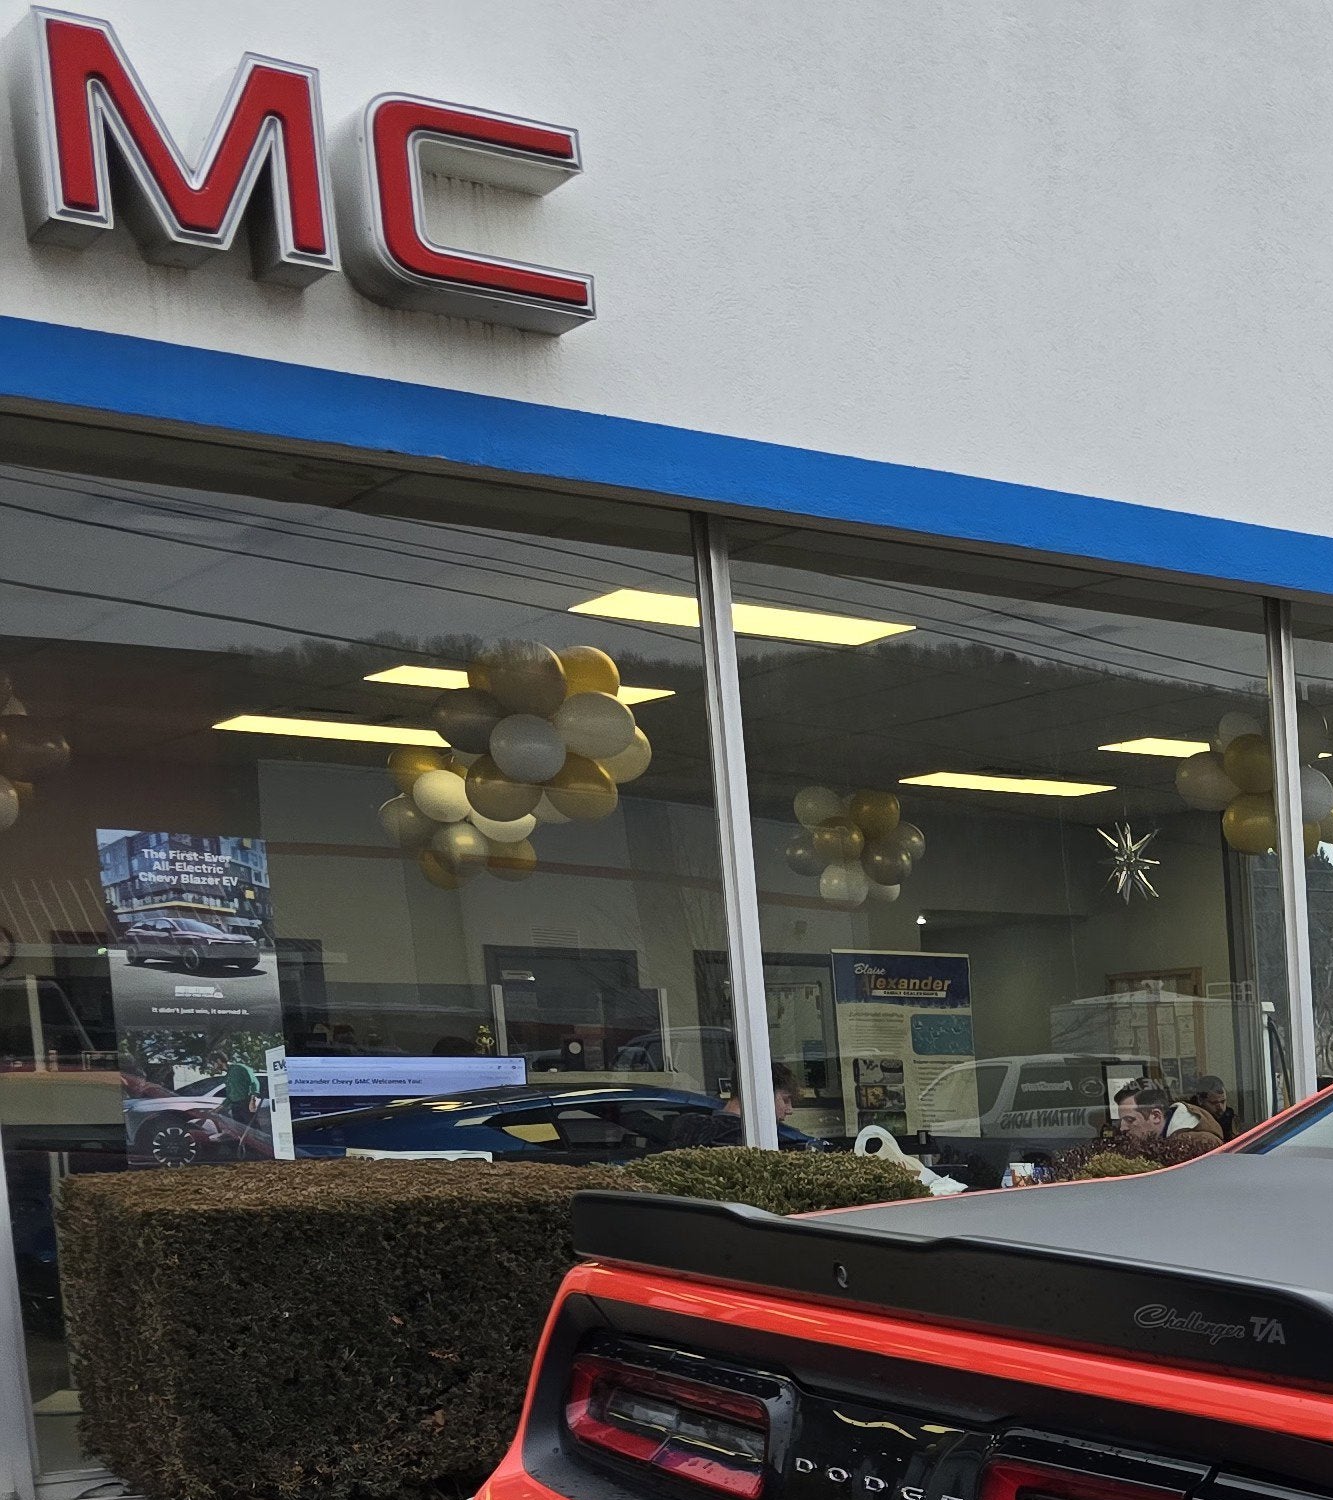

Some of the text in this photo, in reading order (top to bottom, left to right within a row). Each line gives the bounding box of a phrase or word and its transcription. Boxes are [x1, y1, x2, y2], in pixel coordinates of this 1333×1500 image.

[142, 849, 232, 863] The First-Ever
[152, 861, 224, 875] All-Electric
[139, 871, 239, 887] Chevy Blazer EV
[853, 962, 887, 975] Blaise
[331, 1078, 353, 1086] Chevy
[1133, 1303, 1286, 1346] Challenger T/A
